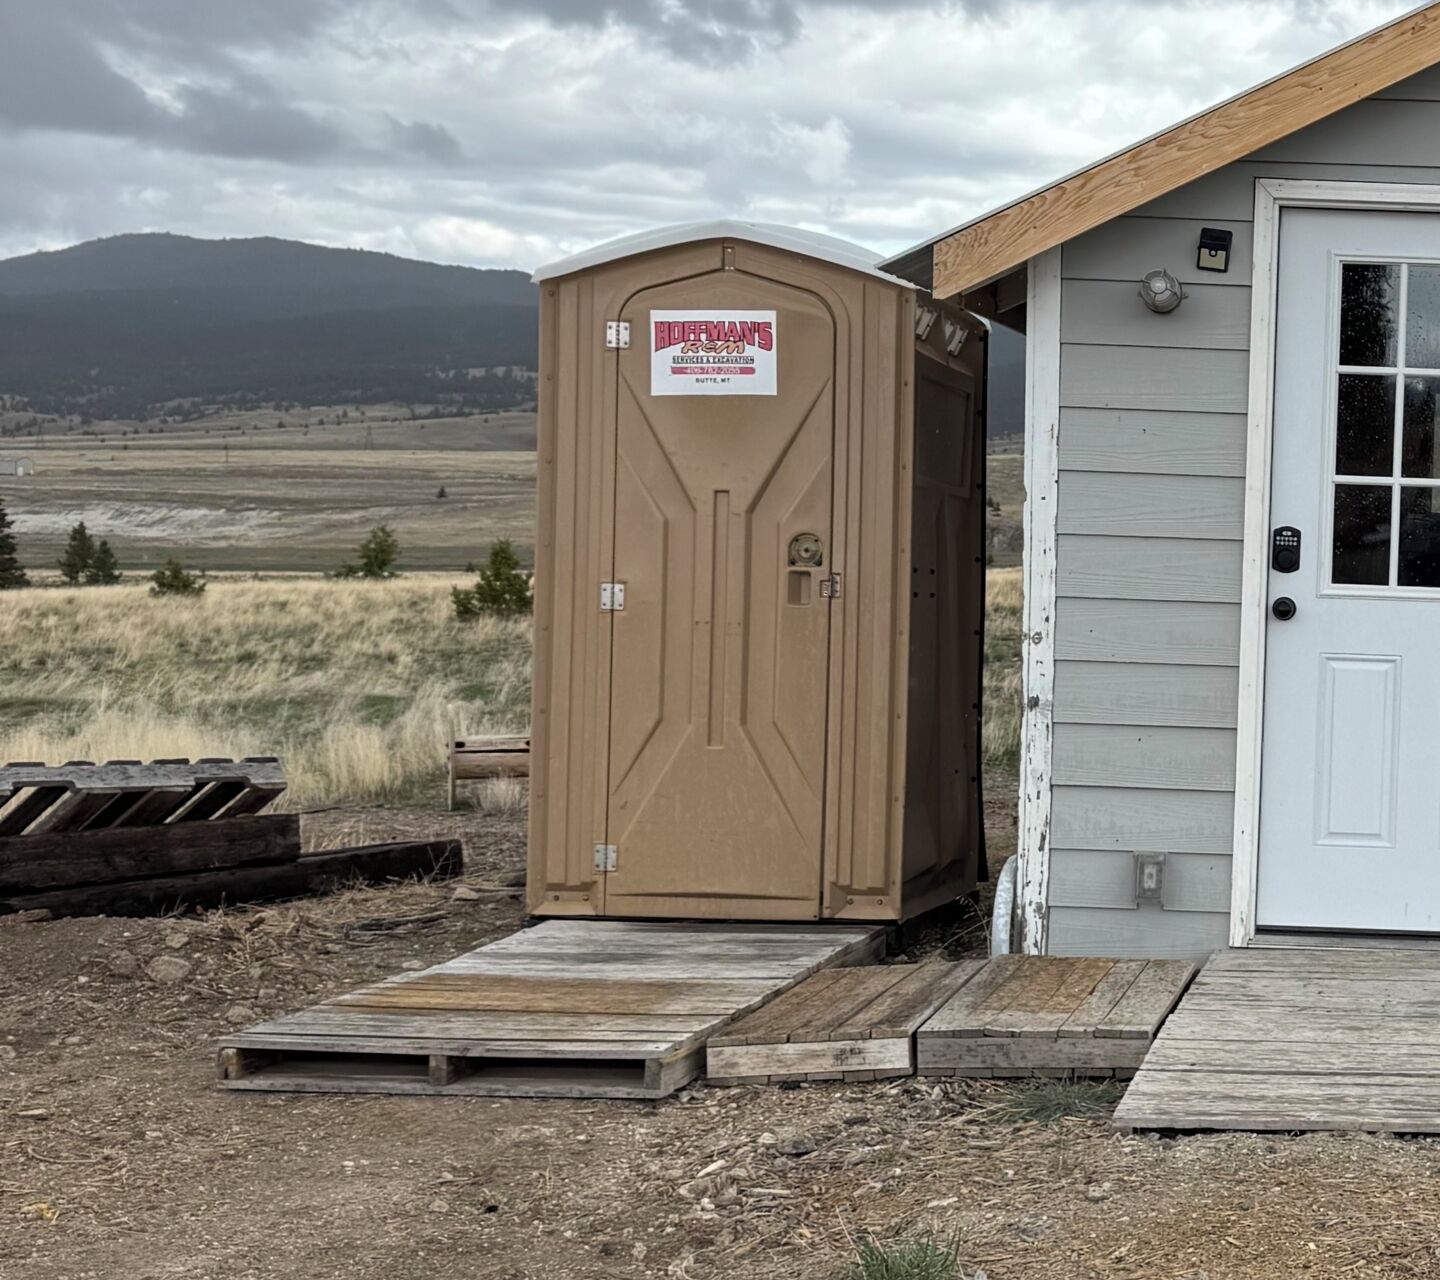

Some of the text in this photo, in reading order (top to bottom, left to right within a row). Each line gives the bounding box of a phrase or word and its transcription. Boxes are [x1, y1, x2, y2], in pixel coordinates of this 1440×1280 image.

[654, 320, 773, 352] HOFFMAN'S
[672, 355, 703, 364] SERVICES
[713, 355, 754, 365] EXCAVATION
